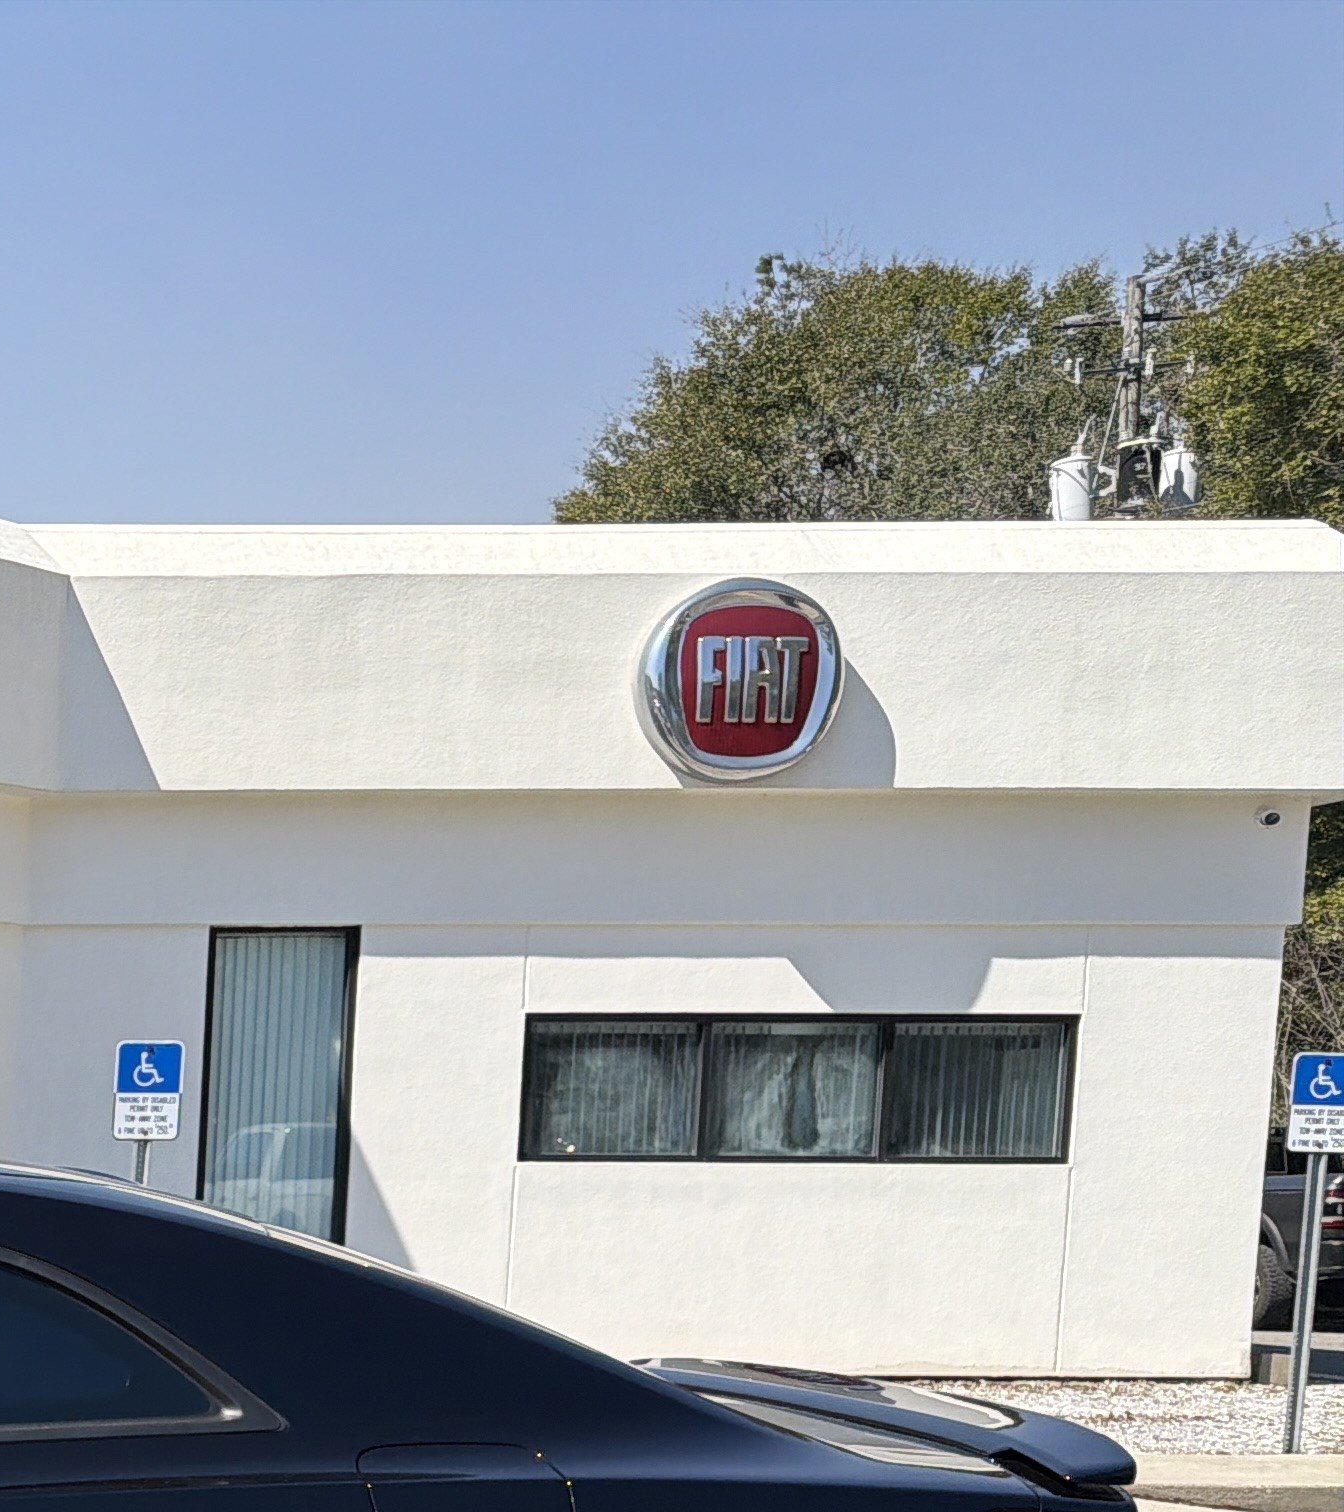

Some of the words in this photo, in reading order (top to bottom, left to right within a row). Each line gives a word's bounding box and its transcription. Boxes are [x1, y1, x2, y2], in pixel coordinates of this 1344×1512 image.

[695, 635, 809, 724] FIAT
[118, 1096, 141, 1104] PARKING
[142, 1096, 149, 1104] BY
[151, 1096, 177, 1105] DISABLED
[1293, 1108, 1316, 1116] PARKING
[1317, 1109, 1325, 1117] BY
[1304, 1117, 1325, 1125] PERMIT
